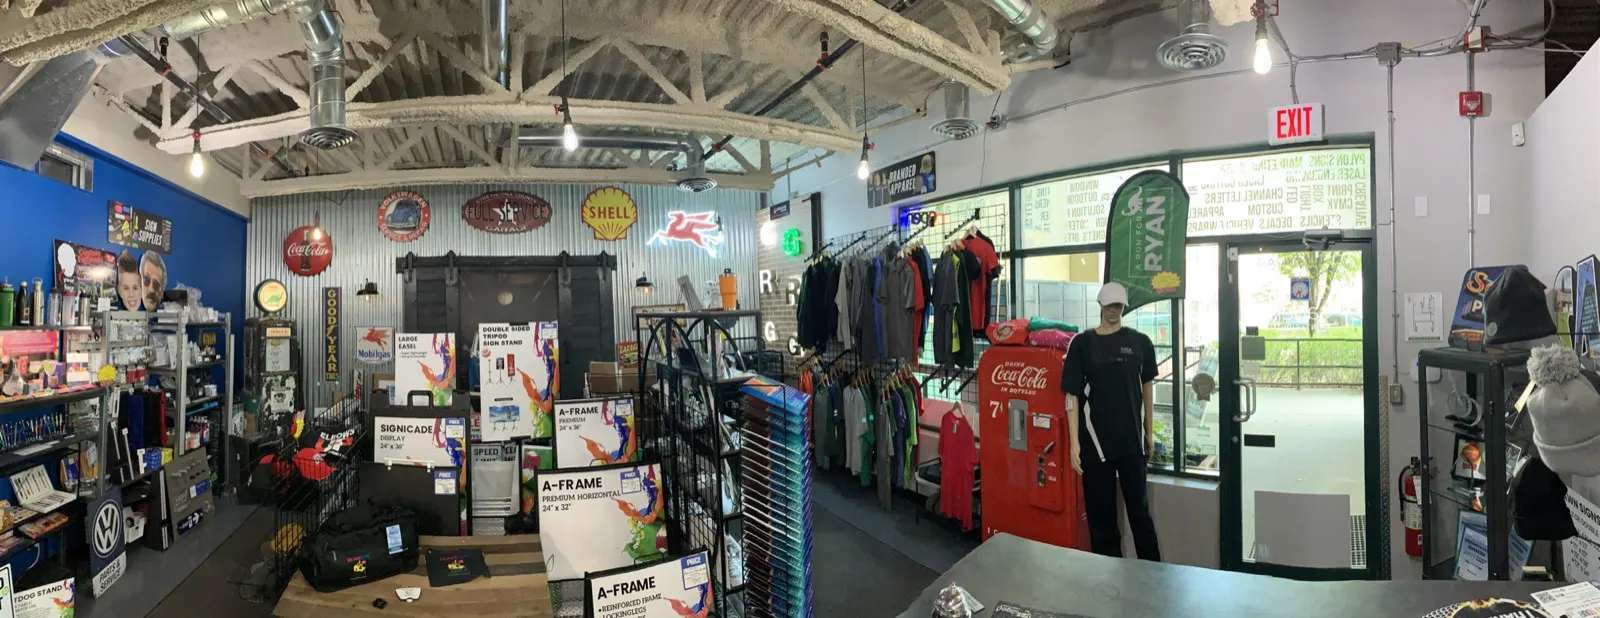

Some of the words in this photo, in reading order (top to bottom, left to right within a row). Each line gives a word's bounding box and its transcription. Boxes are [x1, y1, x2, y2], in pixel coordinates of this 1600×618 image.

[1276, 106, 1313, 139] EXIT
[889, 164, 917, 182] BRANDED
[890, 177, 916, 196] APPAREL
[380, 191, 428, 209] VOLKSWAGEN
[467, 204, 495, 222] FULL
[498, 201, 547, 223] SERVICE
[589, 206, 631, 220] SHELL
[144, 218, 159, 233] SIGN
[485, 224, 529, 233] GARAGE
[1135, 215, 1143, 236] FOR
[1144, 195, 1166, 271] RYAN
[138, 229, 164, 246] SUPPLIES
[1135, 239, 1143, 260] RUN
[358, 348, 391, 360] Mobilgas
[991, 363, 1049, 390] Coca-Cola
[1009, 387, 1036, 395] BOTTLES
[559, 406, 599, 416] A-FRAME
[380, 424, 433, 434] SIGNICADE
[473, 448, 499, 456] SPEED
[542, 477, 603, 492] A-FRAME
[542, 493, 576, 503] PREMIUM
[577, 490, 622, 501] HORIZONTAL
[542, 504, 554, 512] 24"
[560, 503, 571, 511] 32"
[1579, 502, 1600, 526] SIGNS
[687, 556, 701, 566] PRICE
[99, 565, 116, 584] PARTS
[116, 559, 121, 568] &
[99, 567, 121, 593] SERVICE
[14, 592, 36, 604] TDOG
[37, 584, 63, 597] STAND
[597, 576, 656, 600] A-FRAME
[602, 600, 642, 612] REINFORCED
[642, 593, 662, 604] FRAME
[602, 606, 647, 618] LOCKINGLEGS
